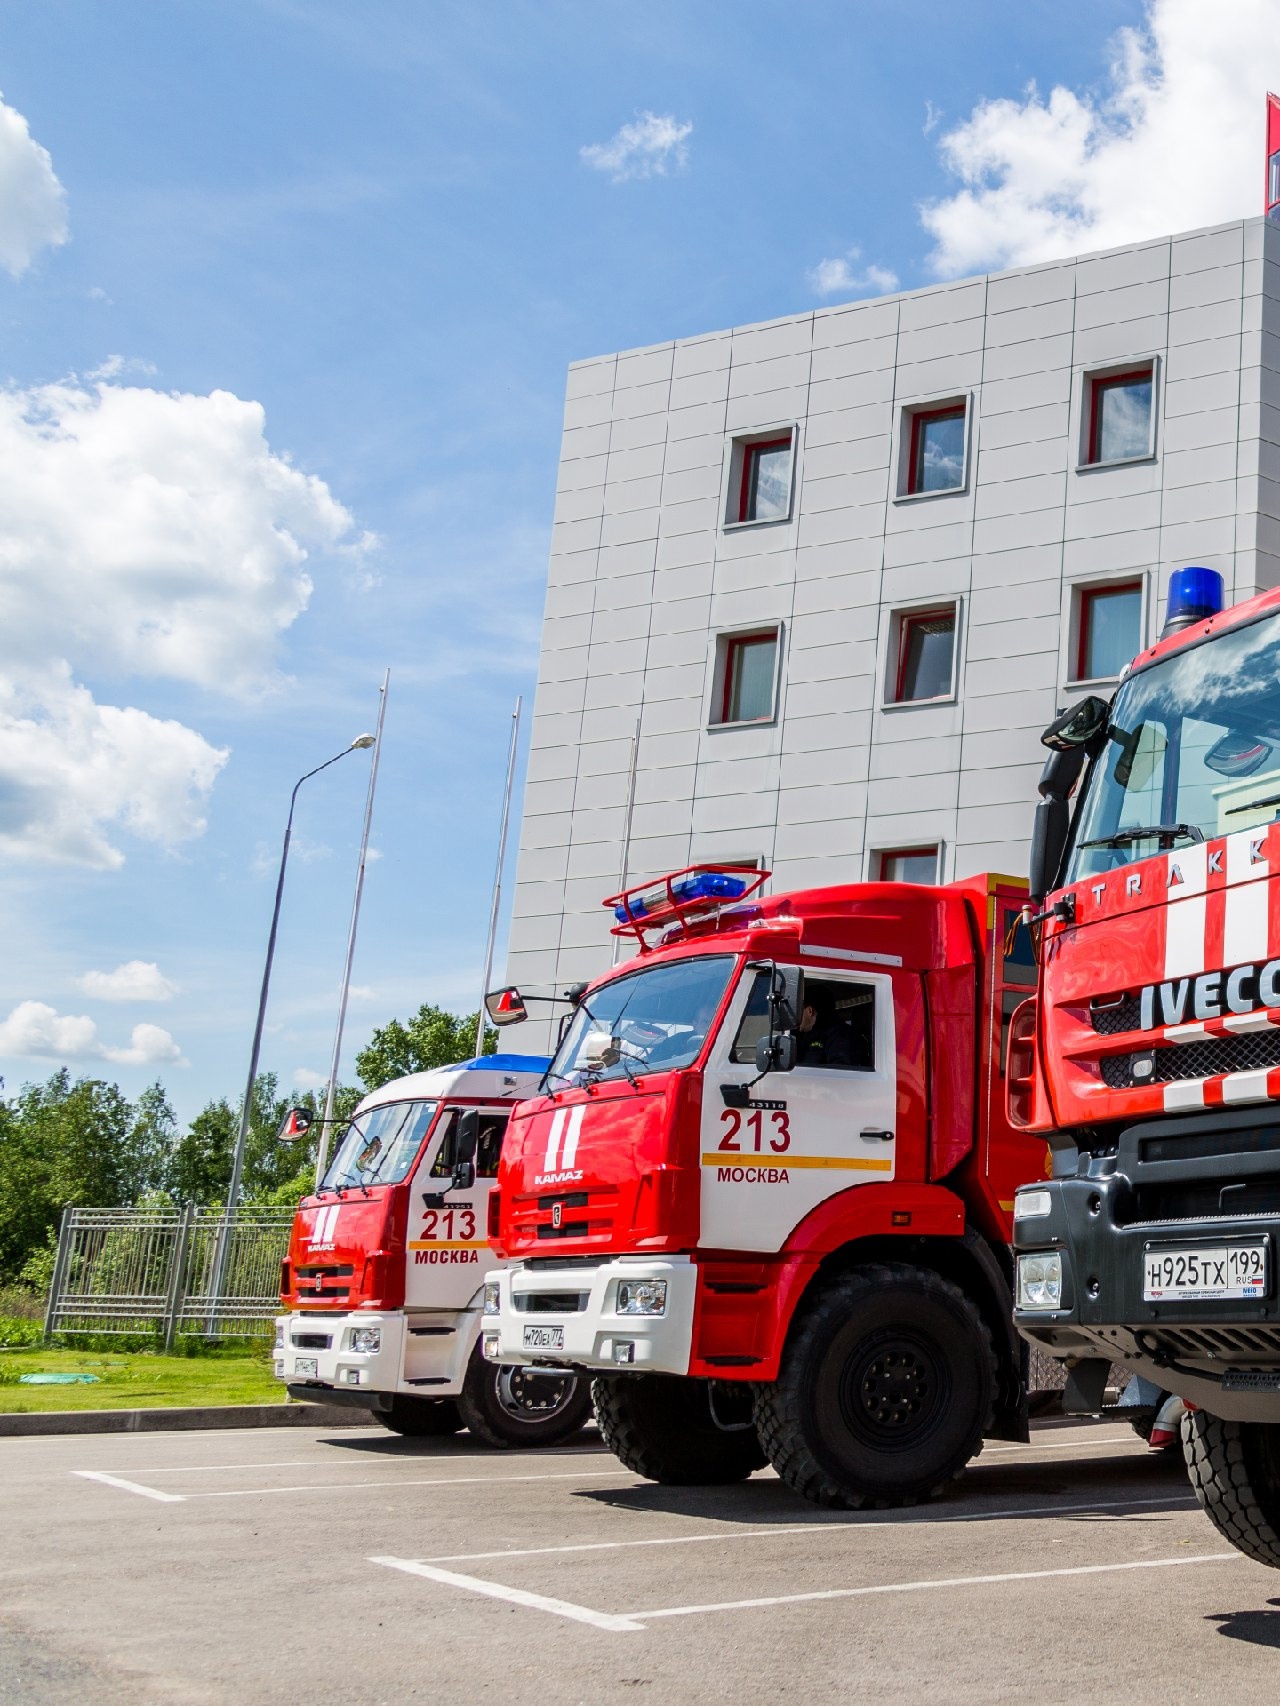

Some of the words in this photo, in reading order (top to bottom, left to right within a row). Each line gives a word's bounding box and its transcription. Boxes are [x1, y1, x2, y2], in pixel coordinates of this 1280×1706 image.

[717, 1108, 791, 1153] 213
[534, 1169, 584, 1185] KAMAZ
[717, 1167, 790, 1184] МОСКВА
[419, 1209, 476, 1241] 213
[307, 1243, 336, 1253] KAMAZ
[414, 1249, 479, 1265] МОСКВА
[1229, 1249, 1261, 1275] 199
[1235, 1275, 1253, 1285] RUS
